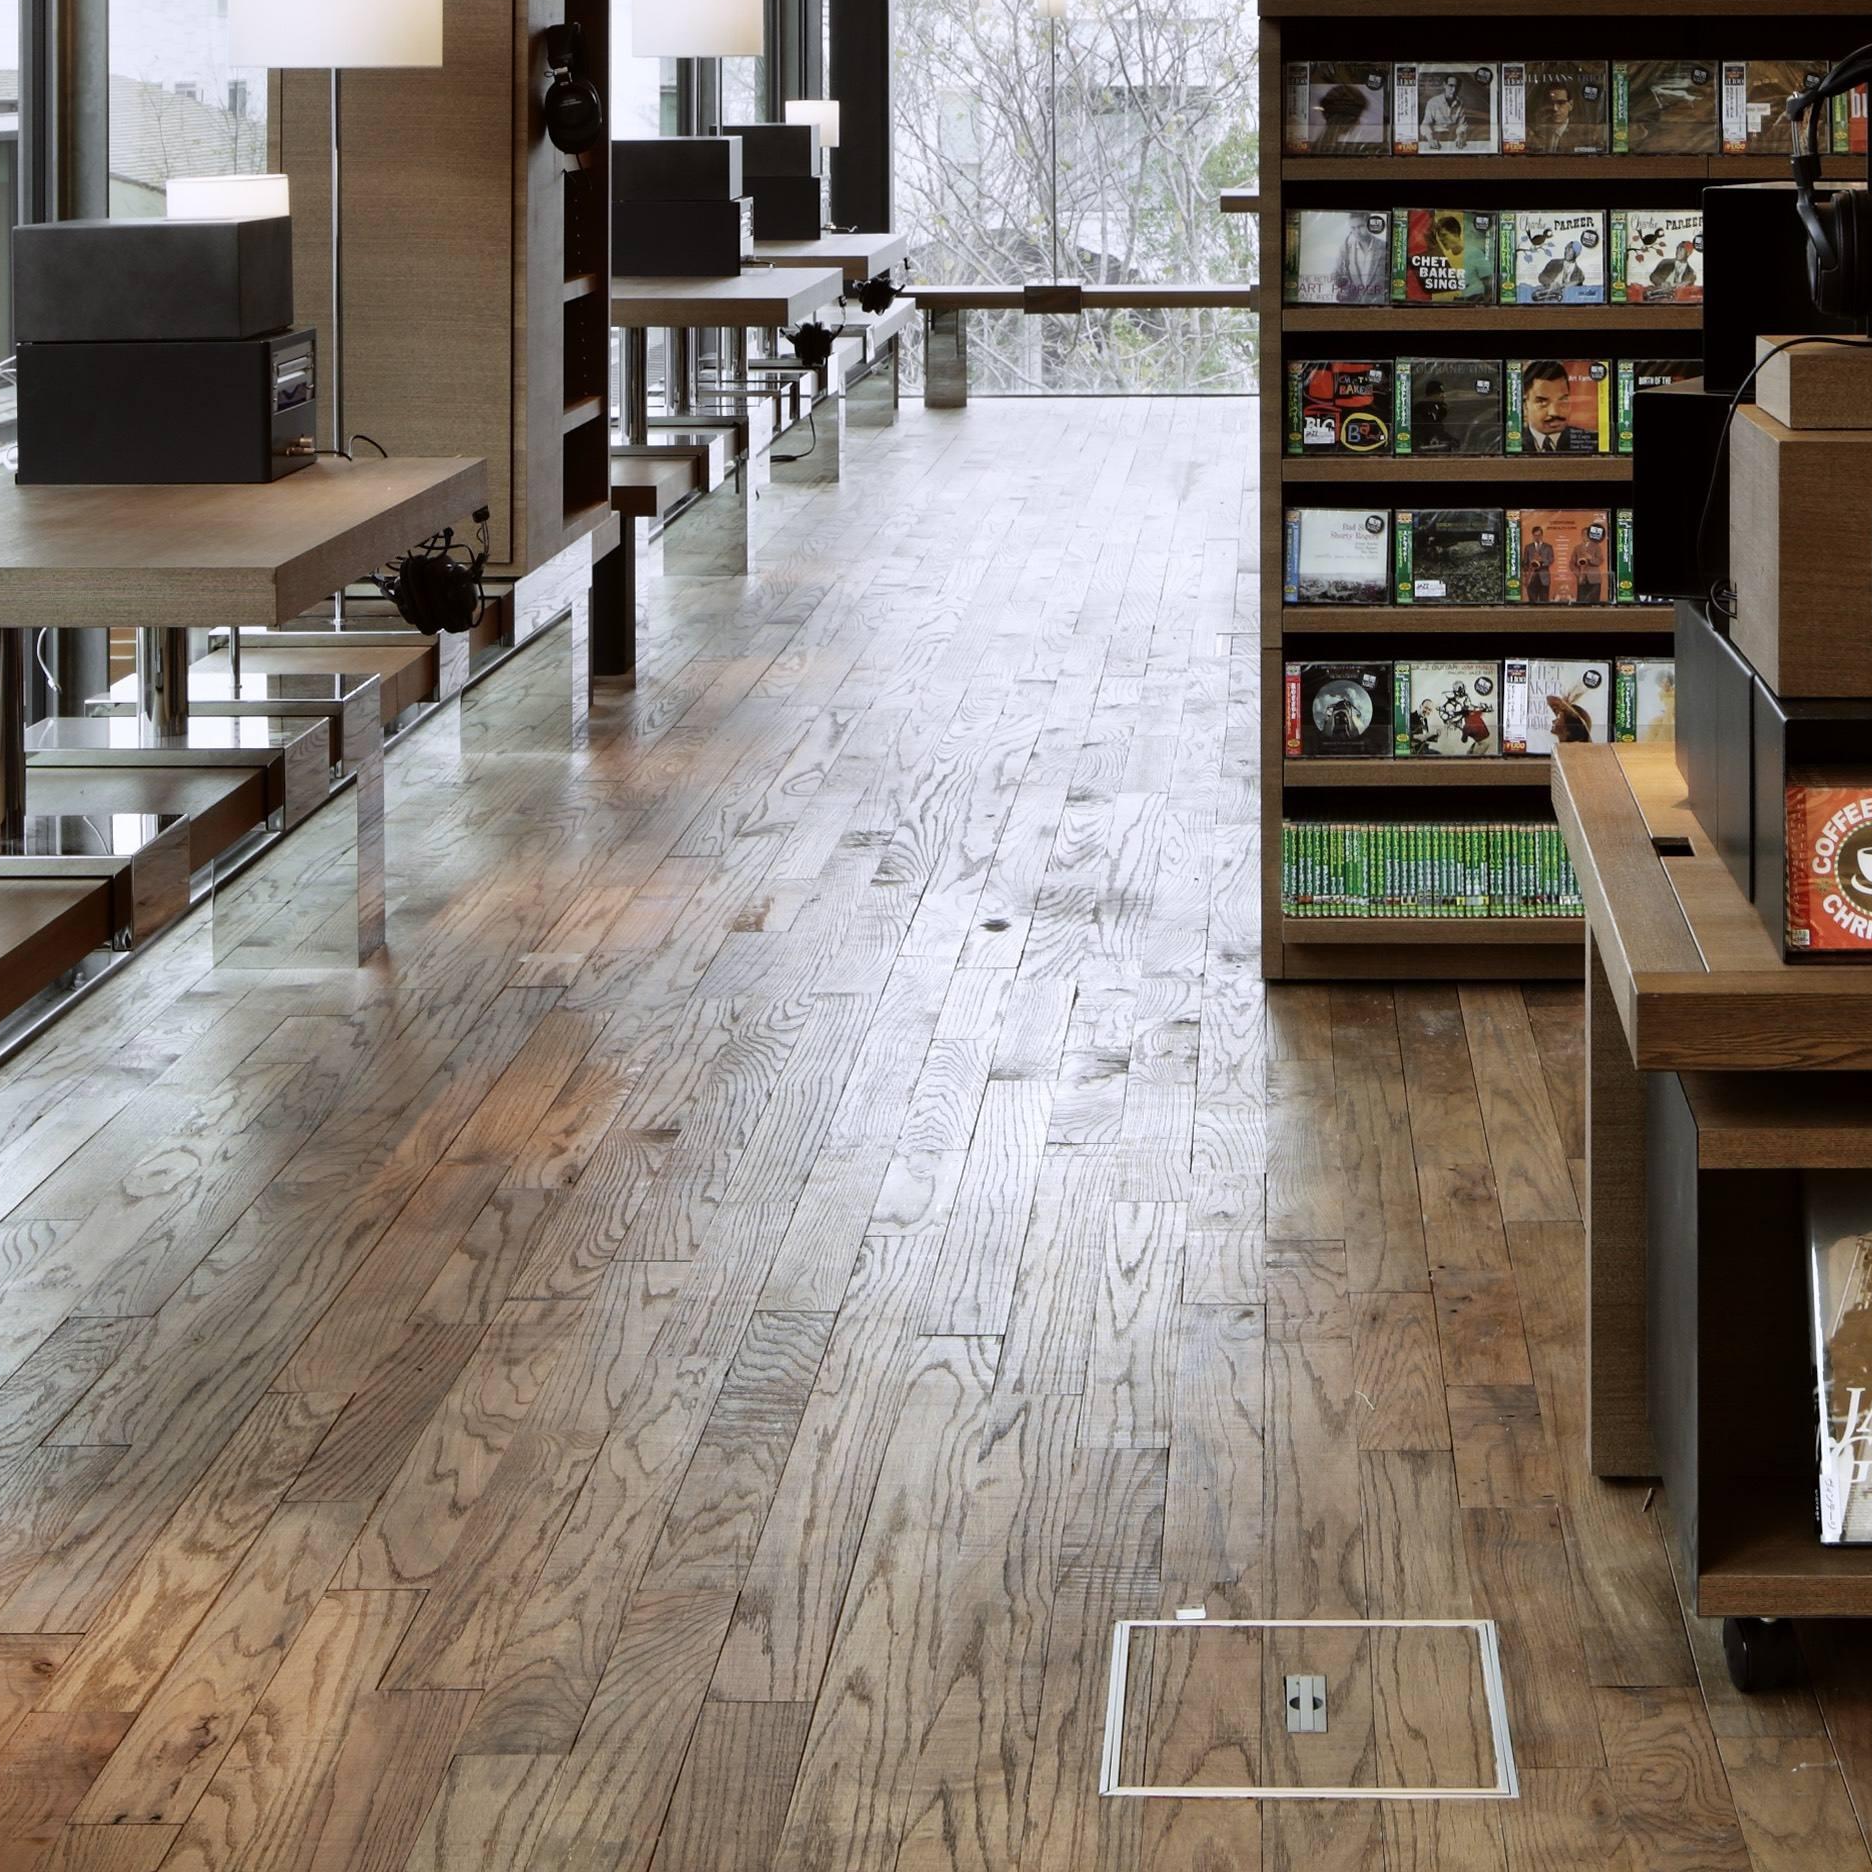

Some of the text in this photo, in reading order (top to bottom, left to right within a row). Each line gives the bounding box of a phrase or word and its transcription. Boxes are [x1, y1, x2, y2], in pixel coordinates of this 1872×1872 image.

[1554, 216, 1595, 230] PARKER
[1412, 255, 1448, 267] CHET
[1419, 267, 1466, 279] BAKER
[1424, 278, 1466, 290] SINGS
[1653, 376, 1661, 385] OF
[1662, 376, 1672, 385] THE
